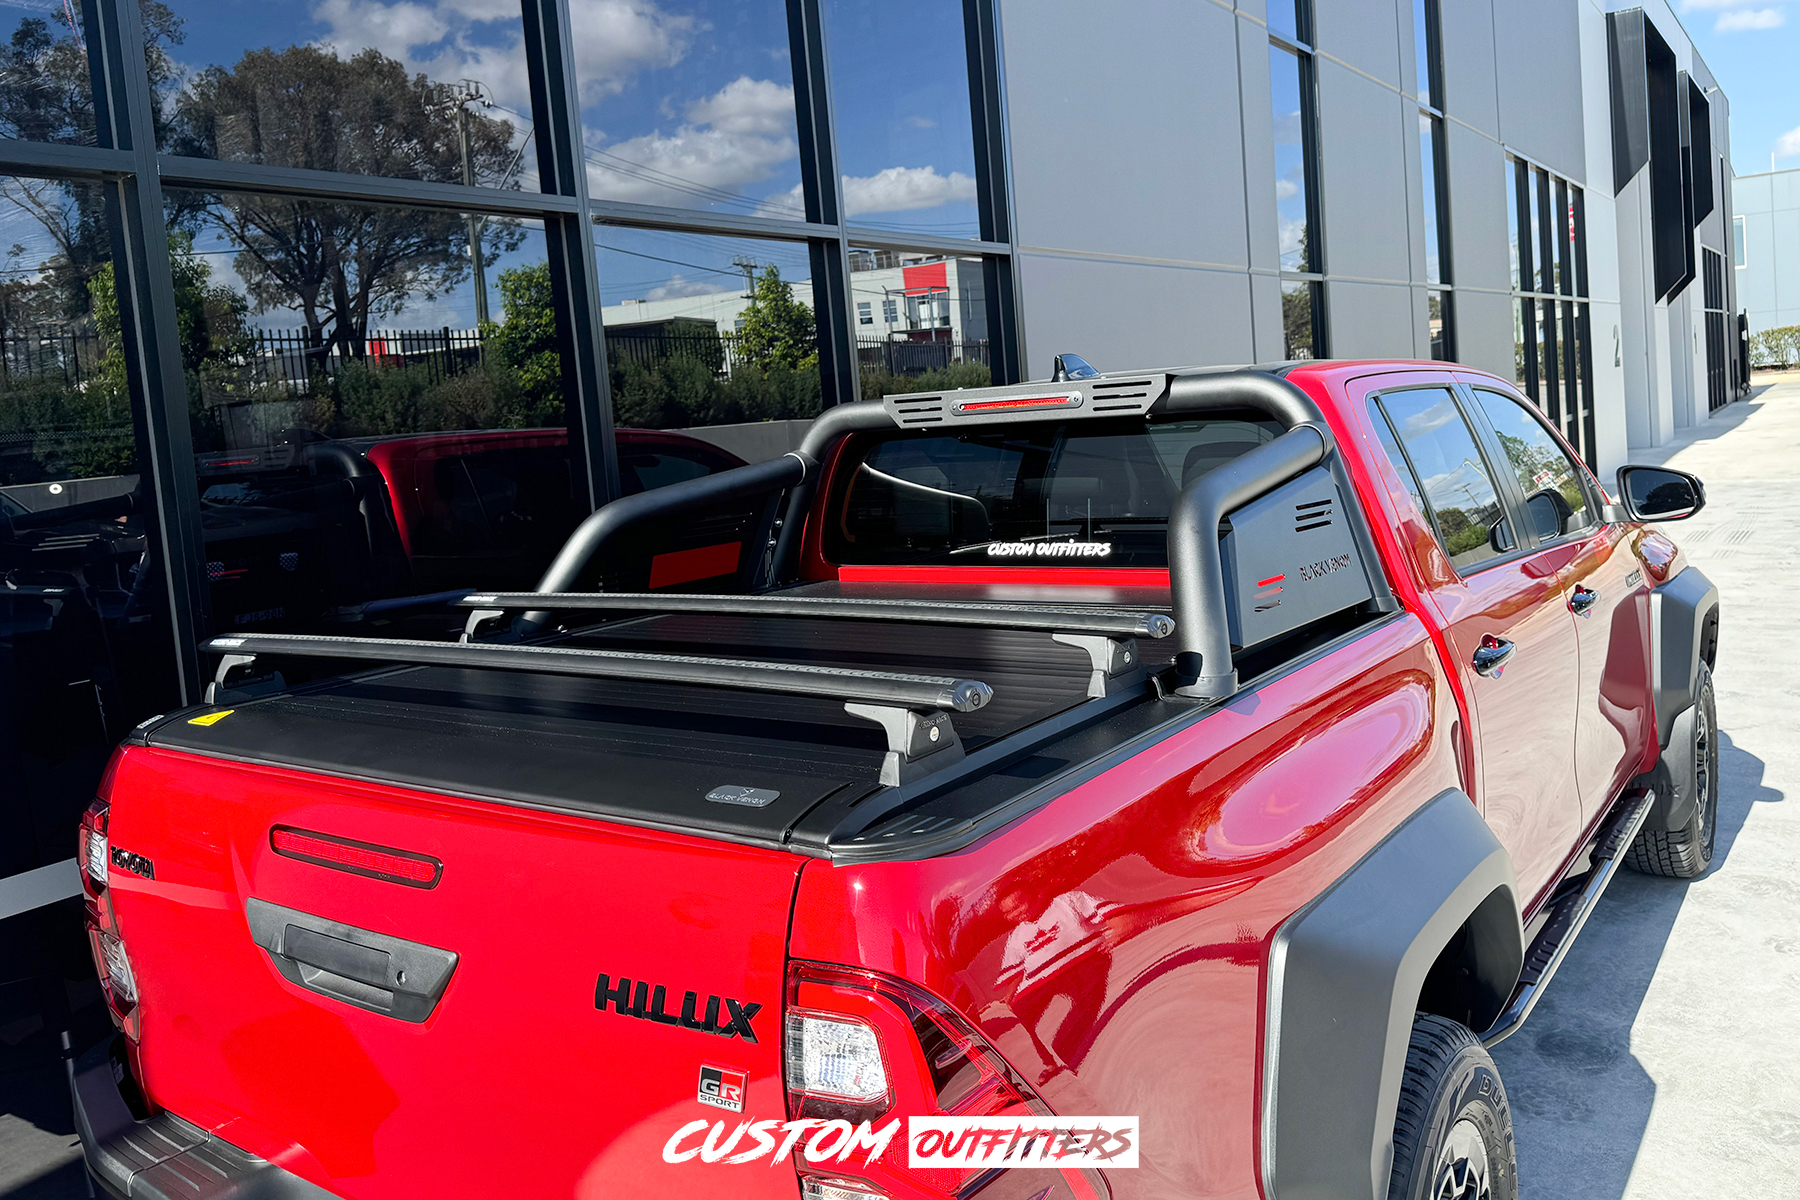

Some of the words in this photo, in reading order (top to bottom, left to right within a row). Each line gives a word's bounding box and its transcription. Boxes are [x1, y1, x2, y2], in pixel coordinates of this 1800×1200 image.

[1613, 324, 1620, 367] 2
[987, 542, 1036, 556] CUSTOM
[110, 845, 155, 881] TOYOTA
[594, 973, 763, 1044] HILUX
[699, 1094, 740, 1109] SPORT
[700, 1077, 741, 1102] GR
[1478, 1073, 1519, 1200] DUELE
